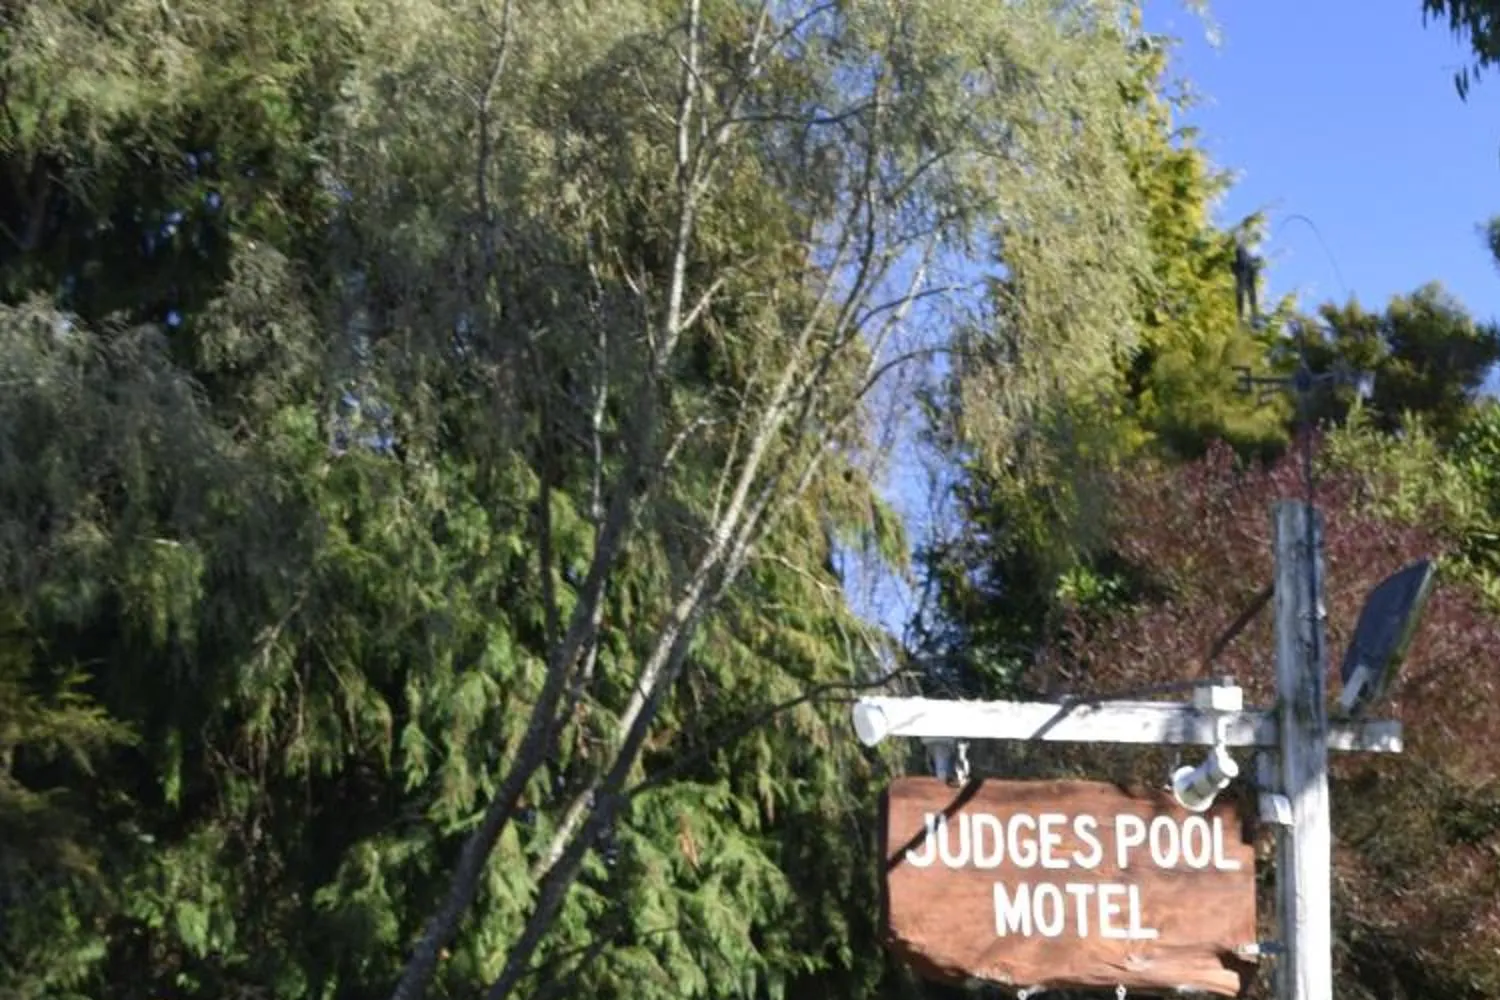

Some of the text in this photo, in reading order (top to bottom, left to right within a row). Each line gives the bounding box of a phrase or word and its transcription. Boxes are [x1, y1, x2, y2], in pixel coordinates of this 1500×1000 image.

[906, 813, 1242, 870] JUDGES POOL
[993, 882, 1159, 939] MOTEL
